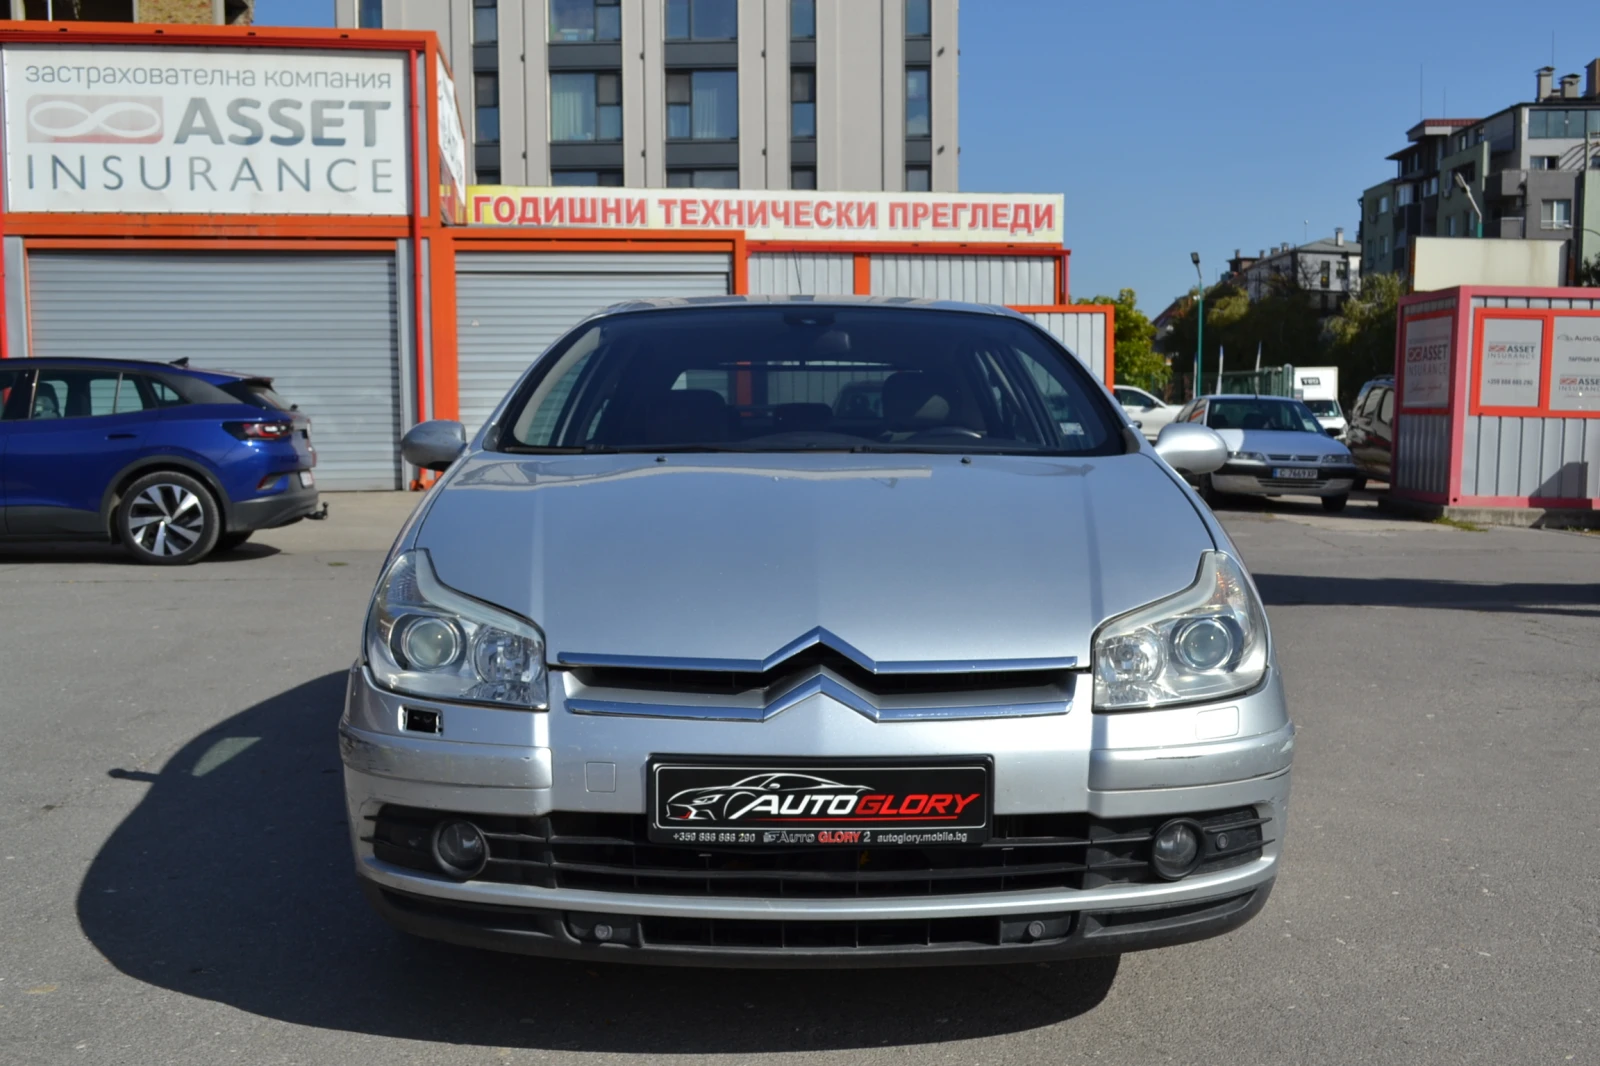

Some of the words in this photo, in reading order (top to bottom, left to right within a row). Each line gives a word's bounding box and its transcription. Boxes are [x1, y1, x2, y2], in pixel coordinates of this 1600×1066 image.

[25, 64, 256, 89] застрахователна
[264, 70, 392, 89] компания
[173, 97, 391, 147] ASSET
[27, 154, 393, 193] INSURANCE
[473, 195, 647, 225] ГОДИШНИ
[658, 198, 878, 228] ТЕХНИЧЕСКИ
[888, 202, 1055, 234] ПРЕГЛЕДИ
[1423, 344, 1448, 360] ASSET
[1507, 345, 1536, 353] ASSET
[673, 832, 696, 841] +359
[817, 831, 862, 843] GLORY
[877, 831, 968, 844] autoglory.mobile.bg
